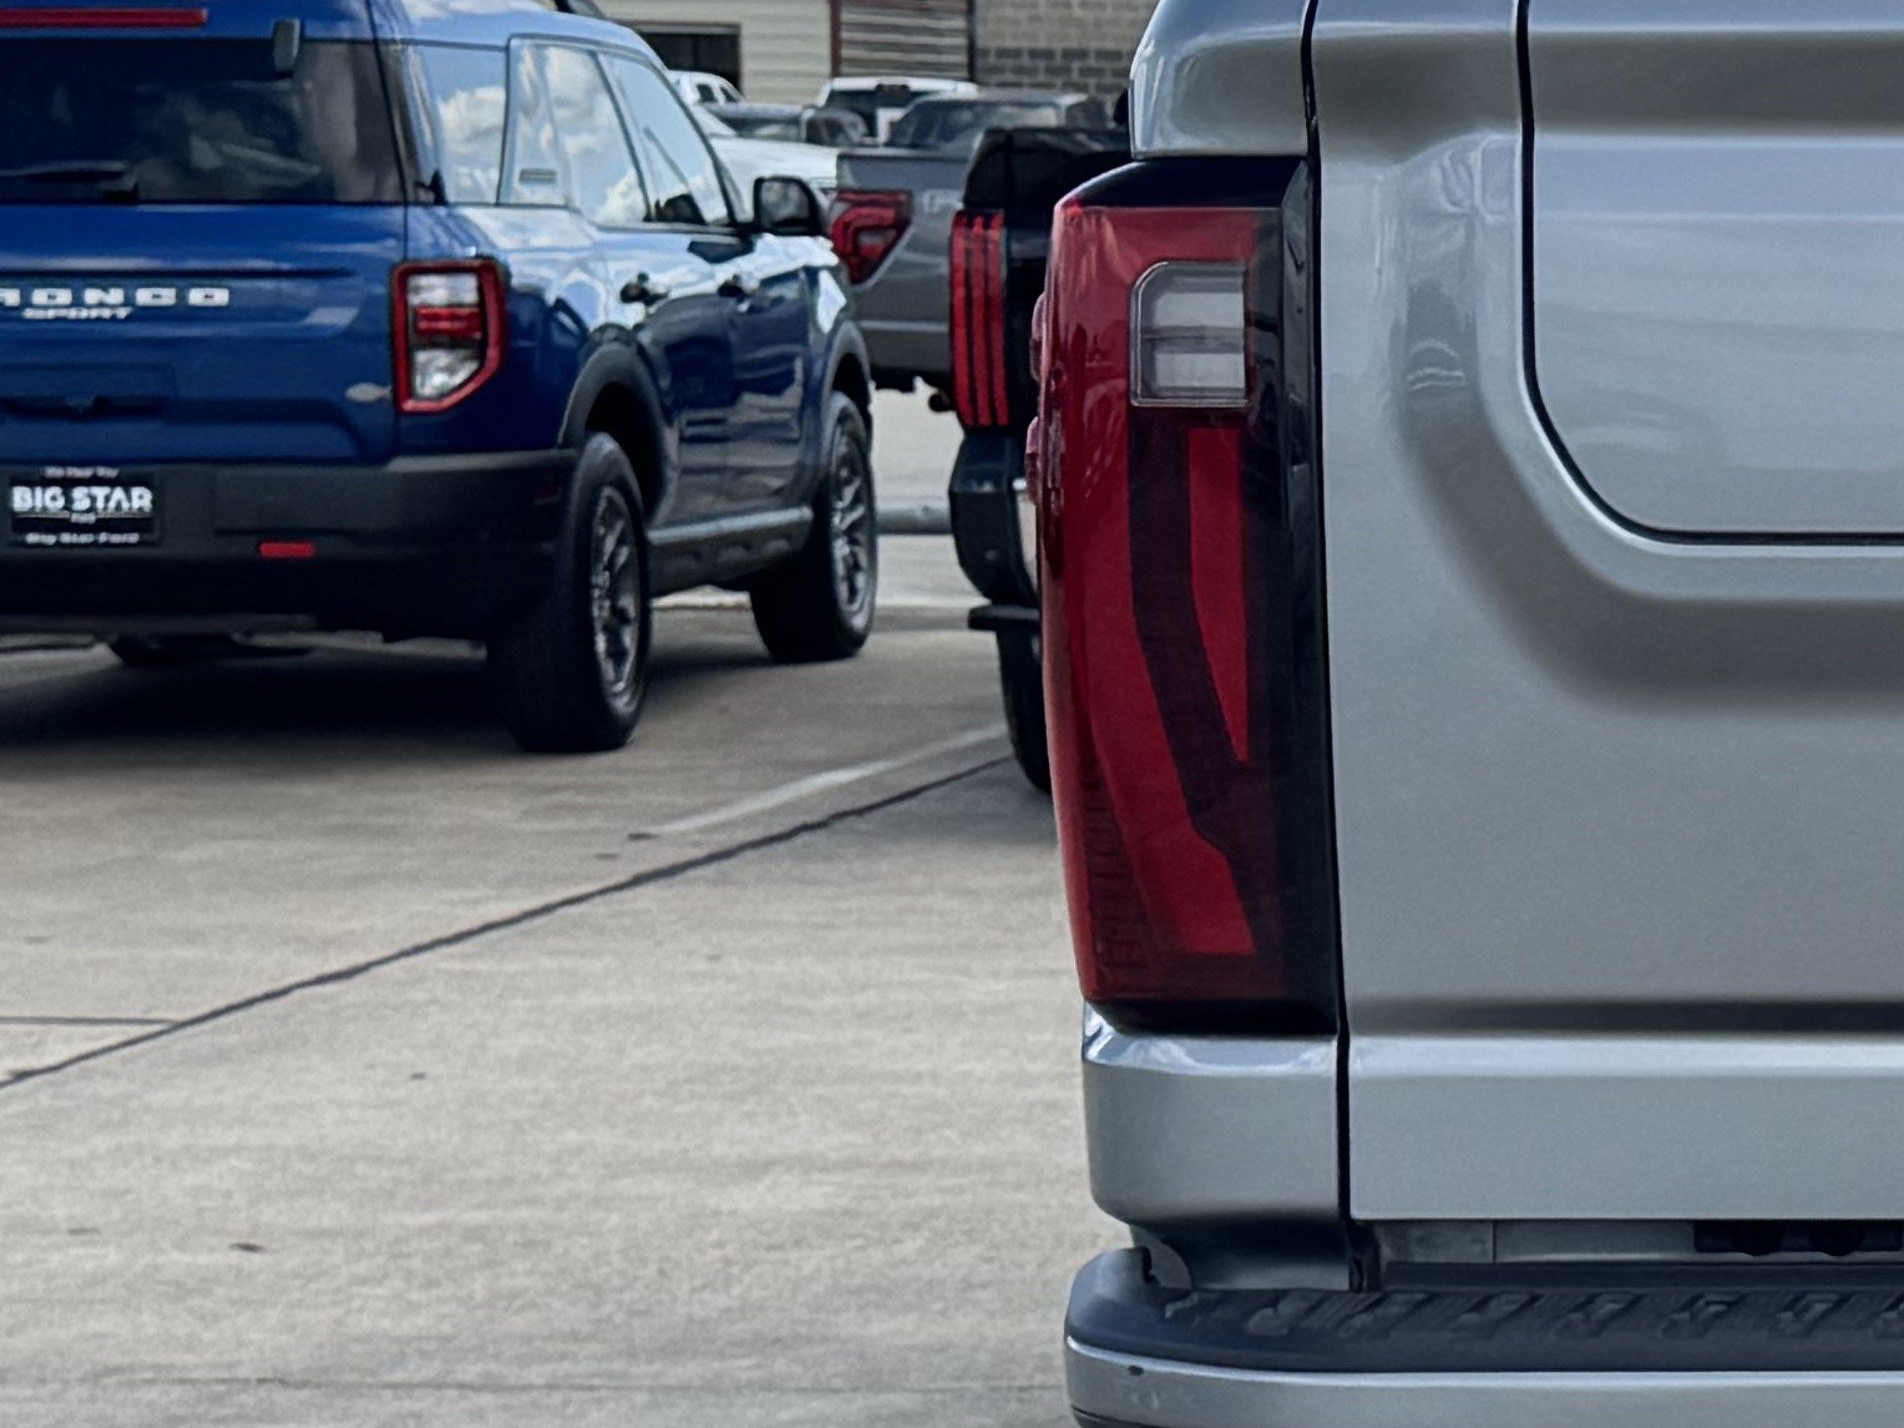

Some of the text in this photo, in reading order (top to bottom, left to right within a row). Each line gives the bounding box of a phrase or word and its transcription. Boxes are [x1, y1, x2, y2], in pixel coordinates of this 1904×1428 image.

[0, 287, 230, 307] RONCO
[12, 486, 153, 512] BIG STAR
